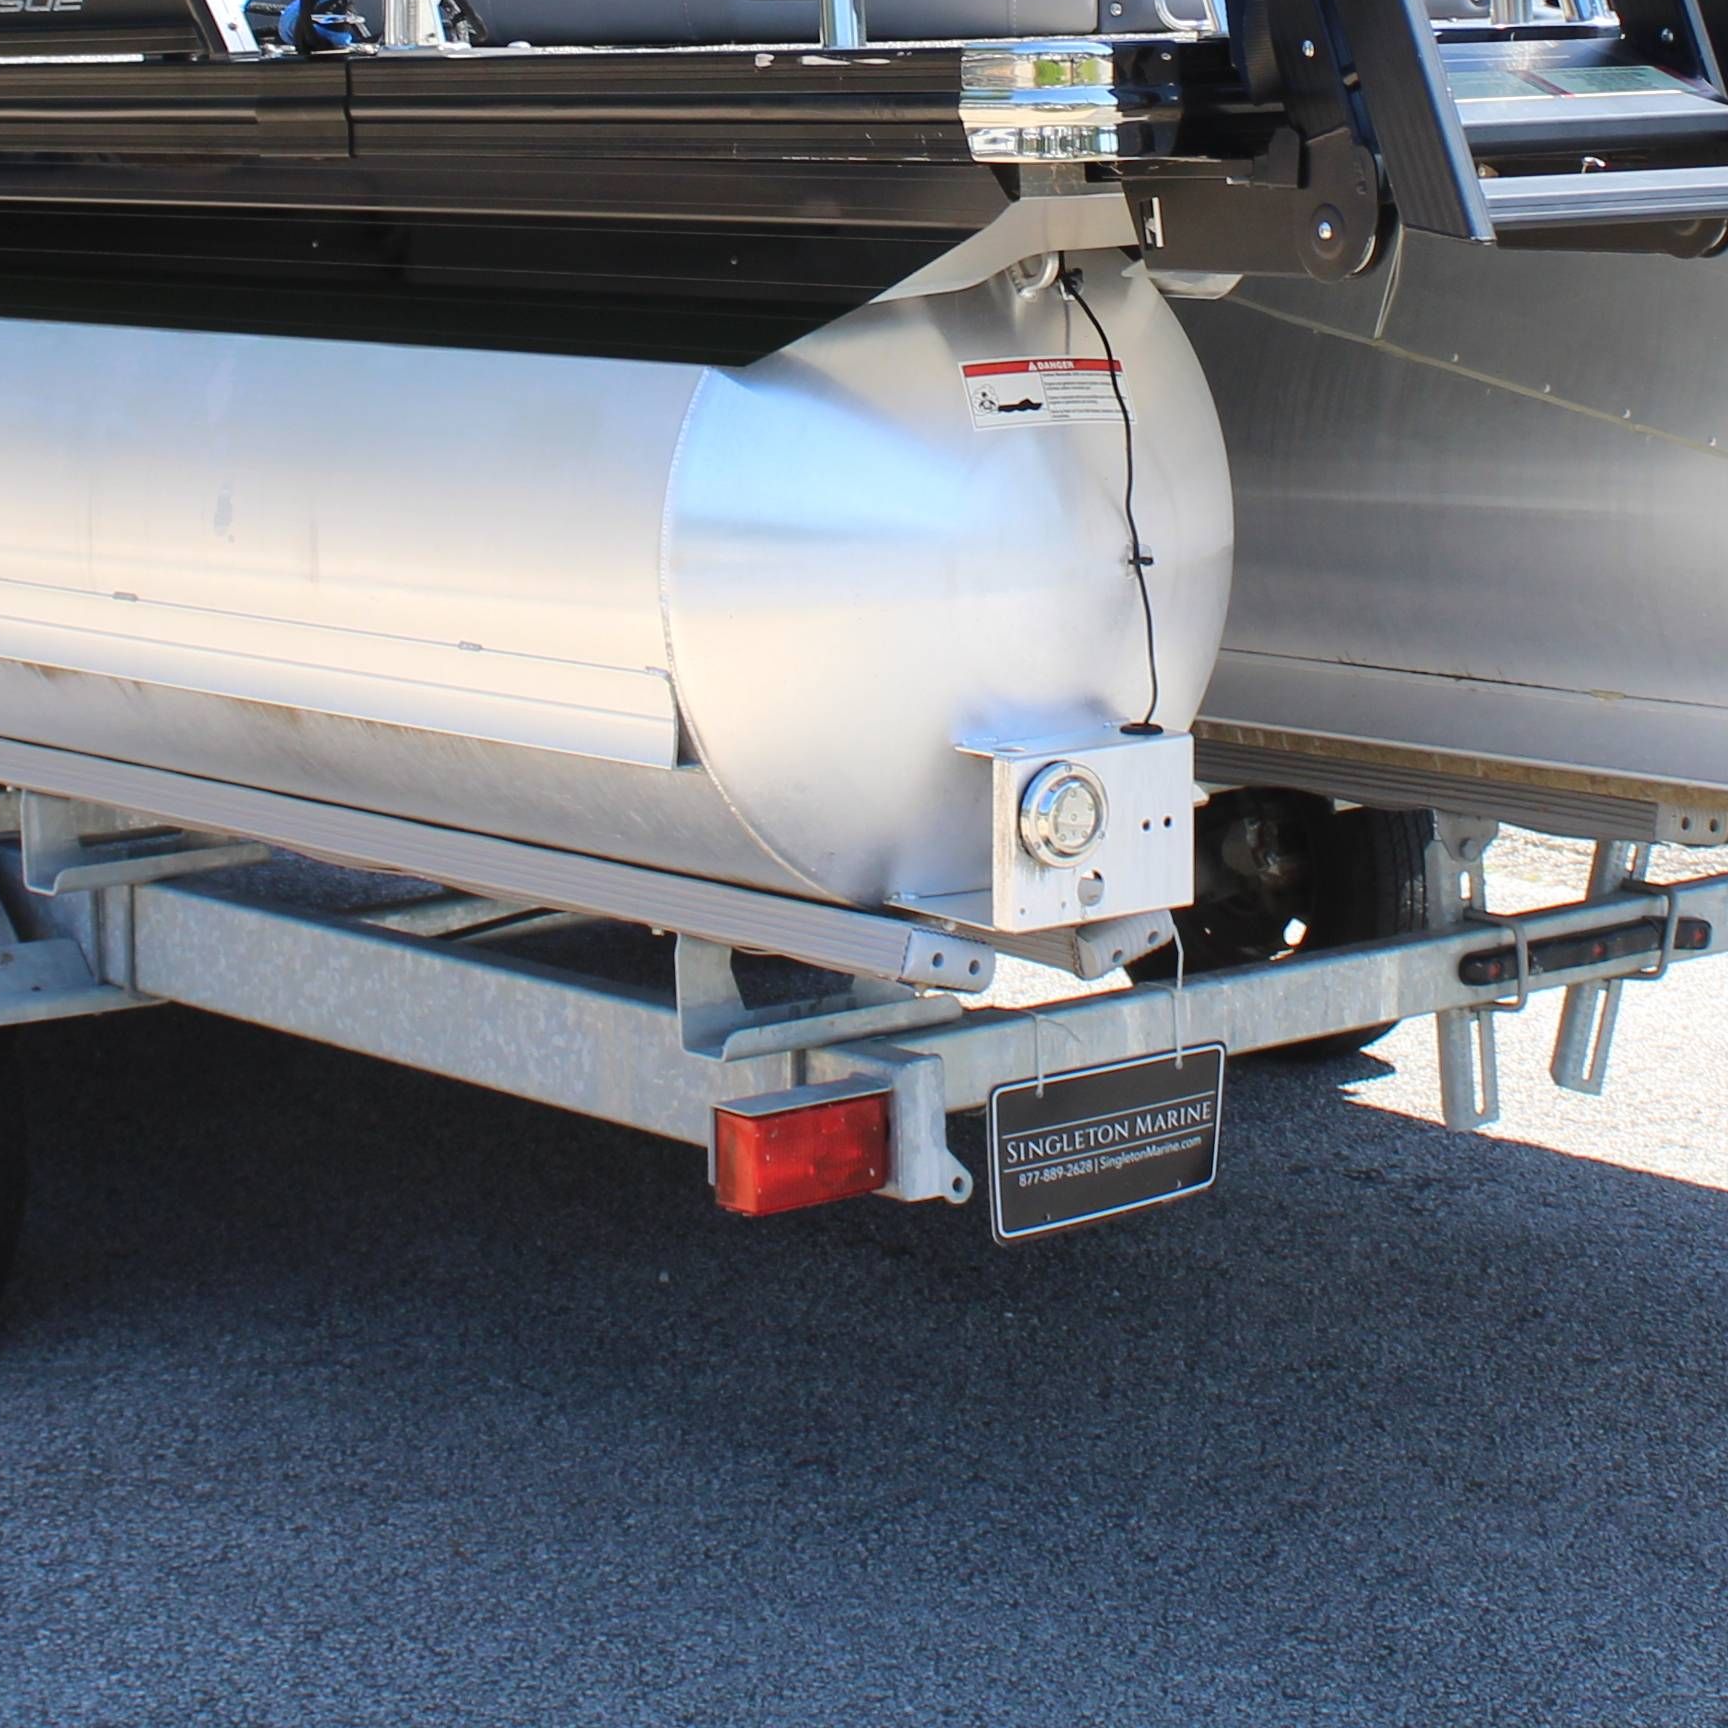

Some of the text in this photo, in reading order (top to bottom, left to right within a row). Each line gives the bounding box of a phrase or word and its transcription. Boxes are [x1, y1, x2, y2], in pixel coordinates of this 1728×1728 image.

[1036, 360, 1075, 370] DANGER
[1007, 1101, 1212, 1164] SINGLETON MARINE
[1100, 1135, 1203, 1171] SingletonMarine.com
